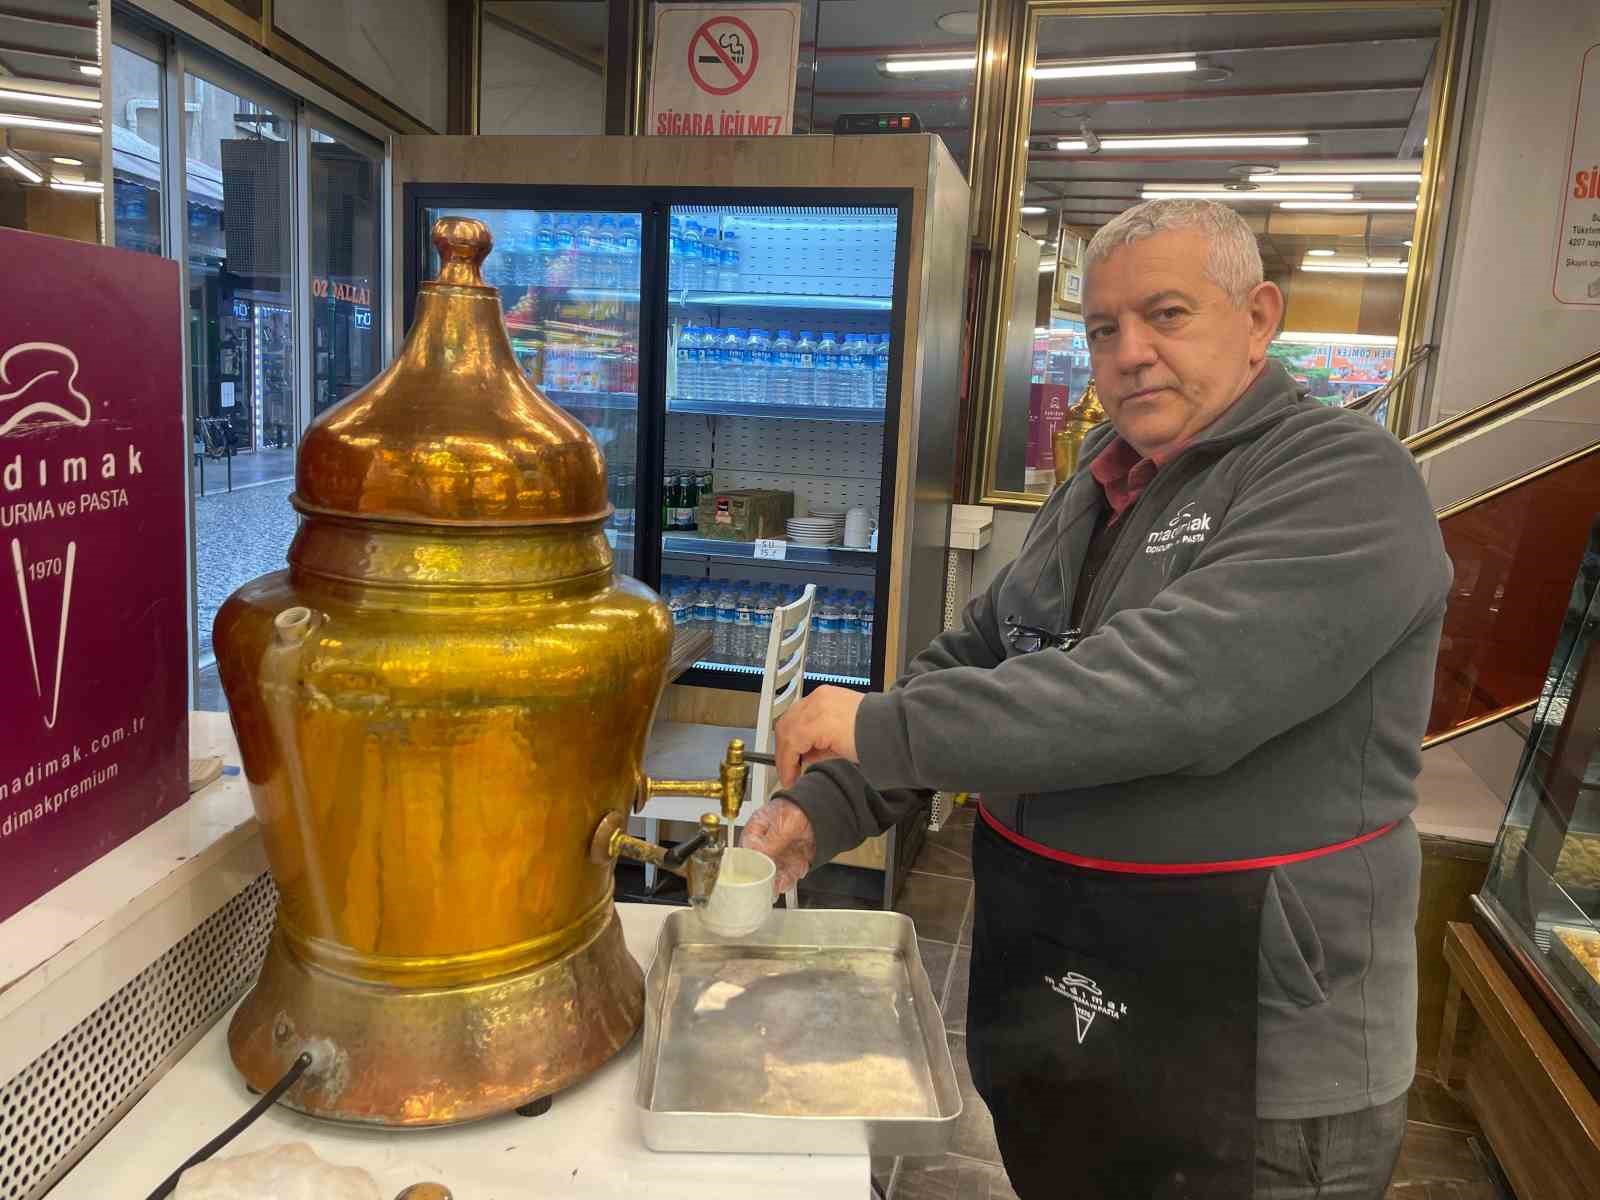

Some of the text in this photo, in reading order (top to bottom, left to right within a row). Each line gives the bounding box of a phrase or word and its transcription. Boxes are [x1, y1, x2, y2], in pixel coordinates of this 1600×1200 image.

[1573, 165, 1600, 200] Sİ
[0, 488, 129, 527] URMA ve PASTA
[28, 557, 62, 581] 1970
[0, 762, 119, 838] dimakpremium
